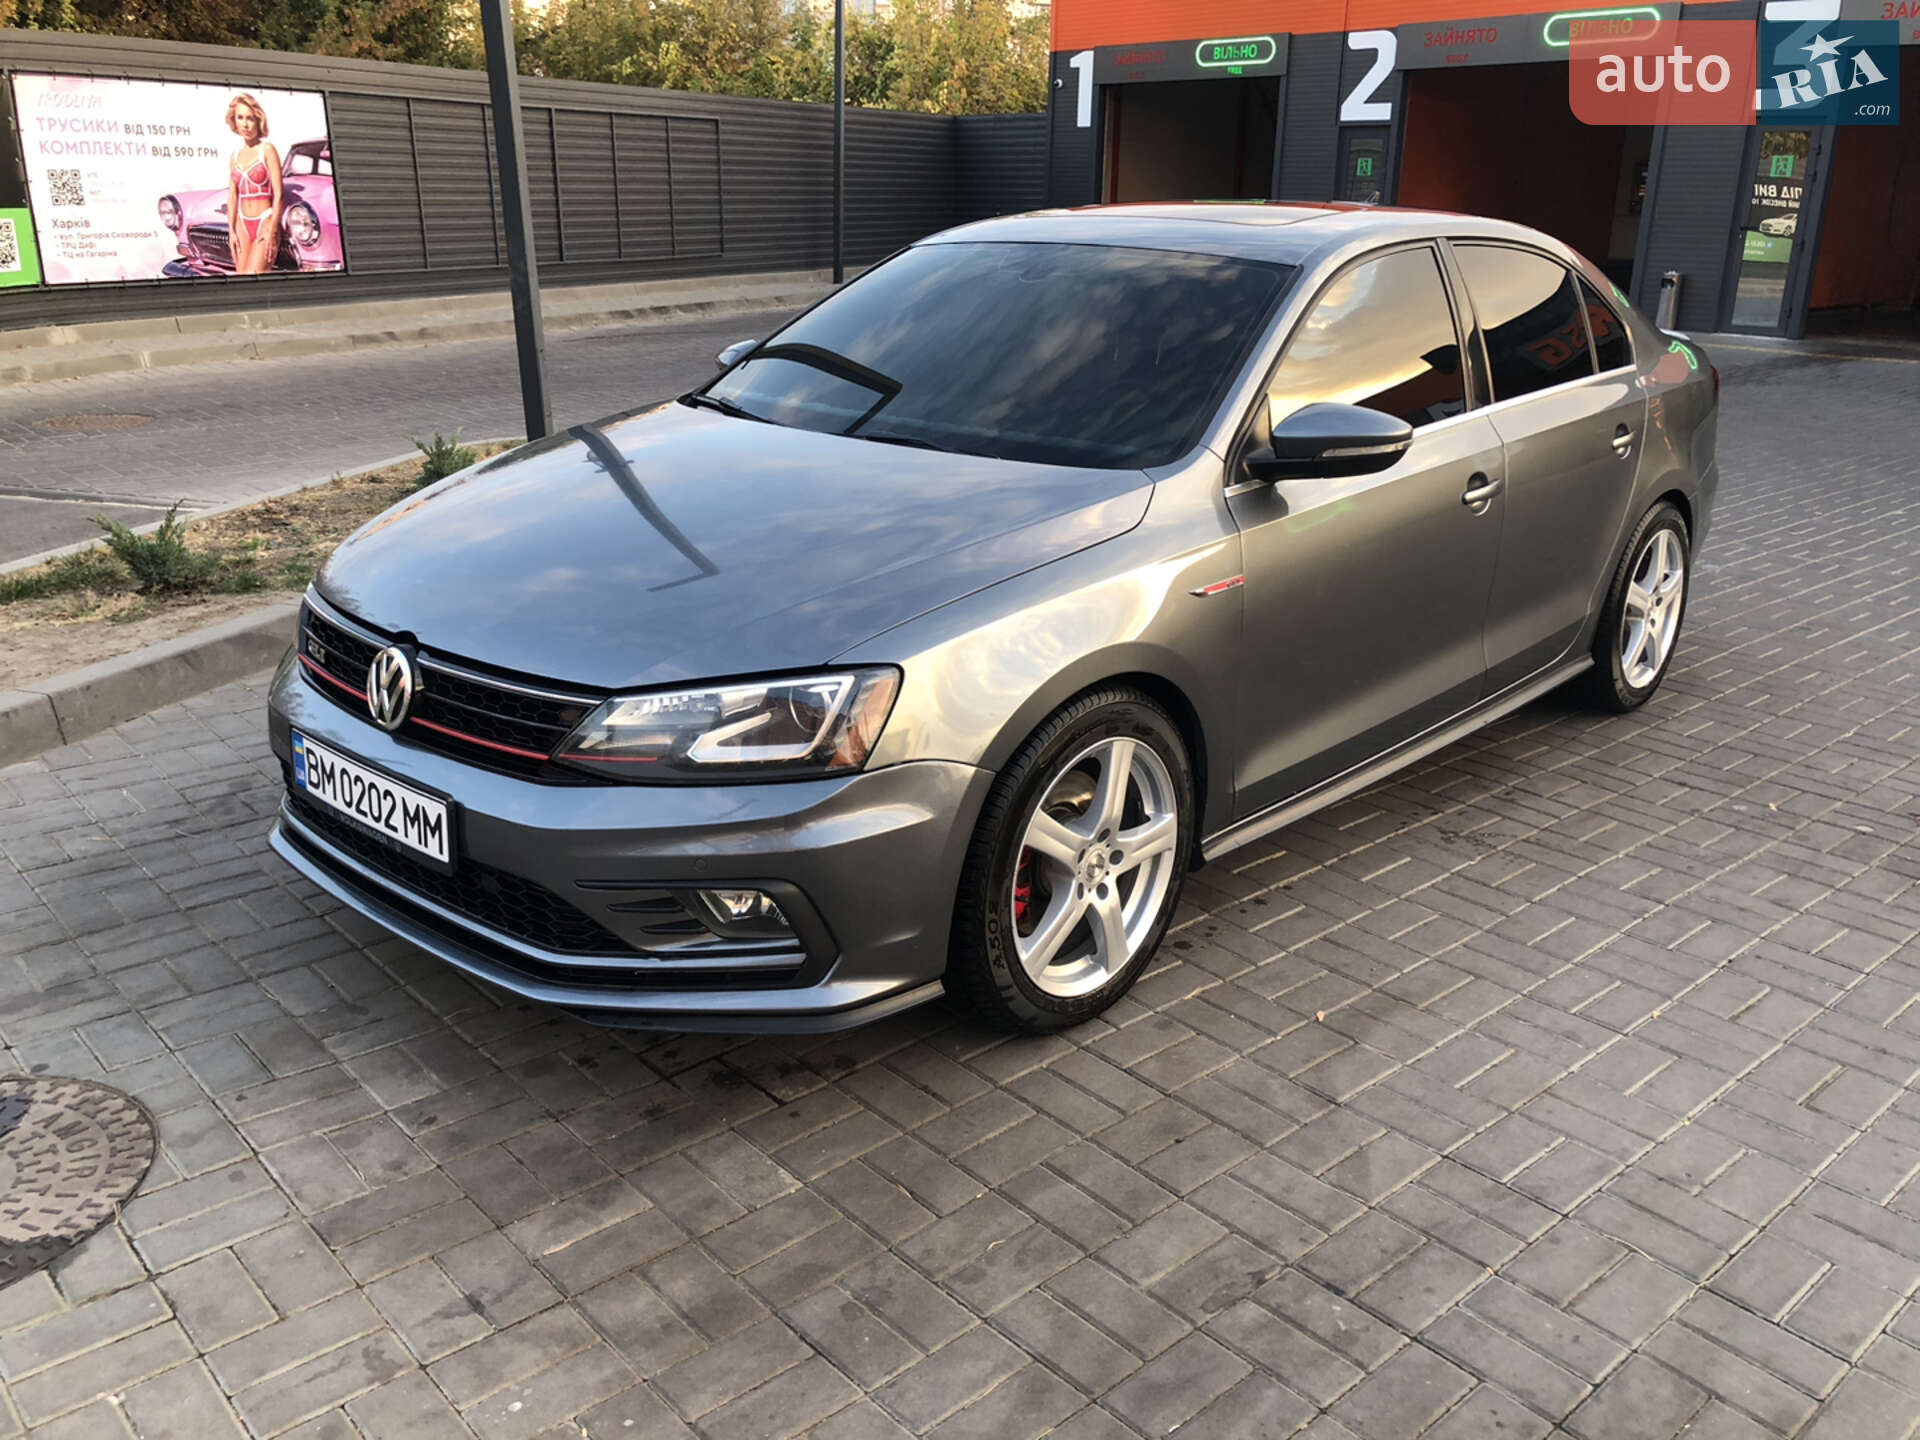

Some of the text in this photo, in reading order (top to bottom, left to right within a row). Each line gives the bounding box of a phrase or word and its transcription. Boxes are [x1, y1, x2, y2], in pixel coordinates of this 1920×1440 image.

[1424, 27, 1498, 48] ЗАЙНЯТО
[1213, 44, 1258, 60] ВІЛЬНО
[1340, 30, 1398, 121] 2
[1070, 50, 1094, 128] 1
[35, 116, 191, 136] ТРУСИКИ ВІД 150 ГРН
[39, 140, 218, 158] КОМПЛЕКТИ ВІД 590 ГРН
[51, 217, 91, 230] Харків
